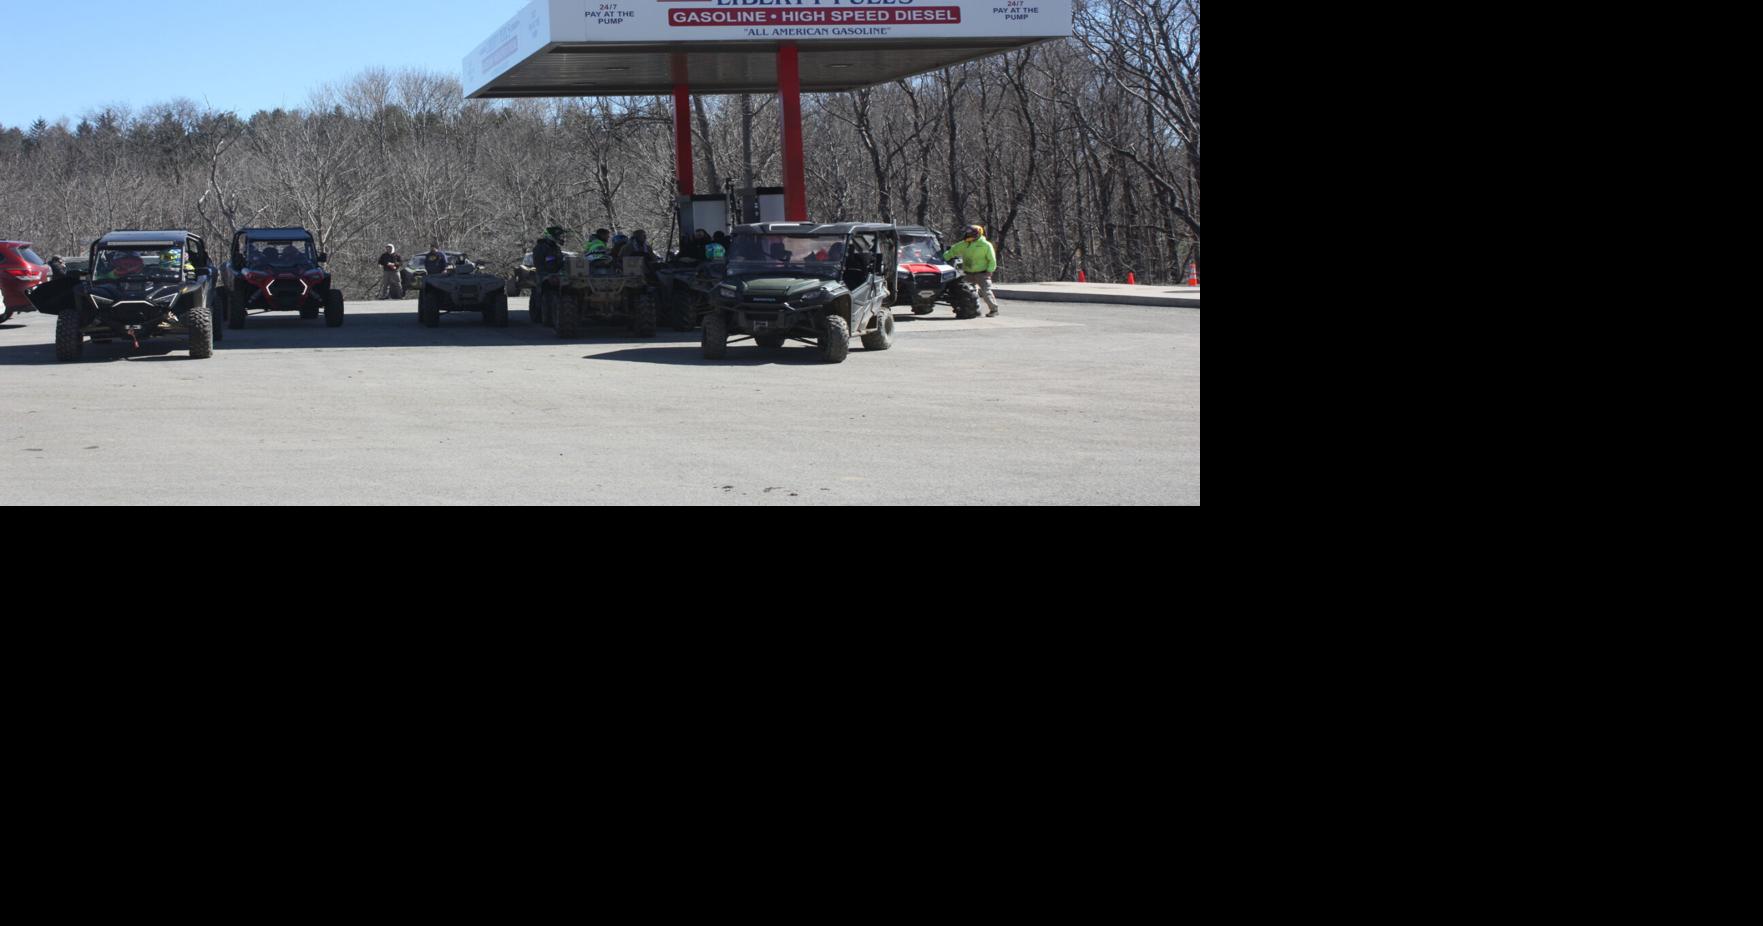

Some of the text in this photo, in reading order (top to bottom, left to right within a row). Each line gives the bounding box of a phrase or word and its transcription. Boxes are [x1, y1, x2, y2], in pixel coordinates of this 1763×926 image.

[672, 9, 958, 23] GASOLINE HIGH SPEED DIESEL
[772, 27, 829, 36] AMERICAN
